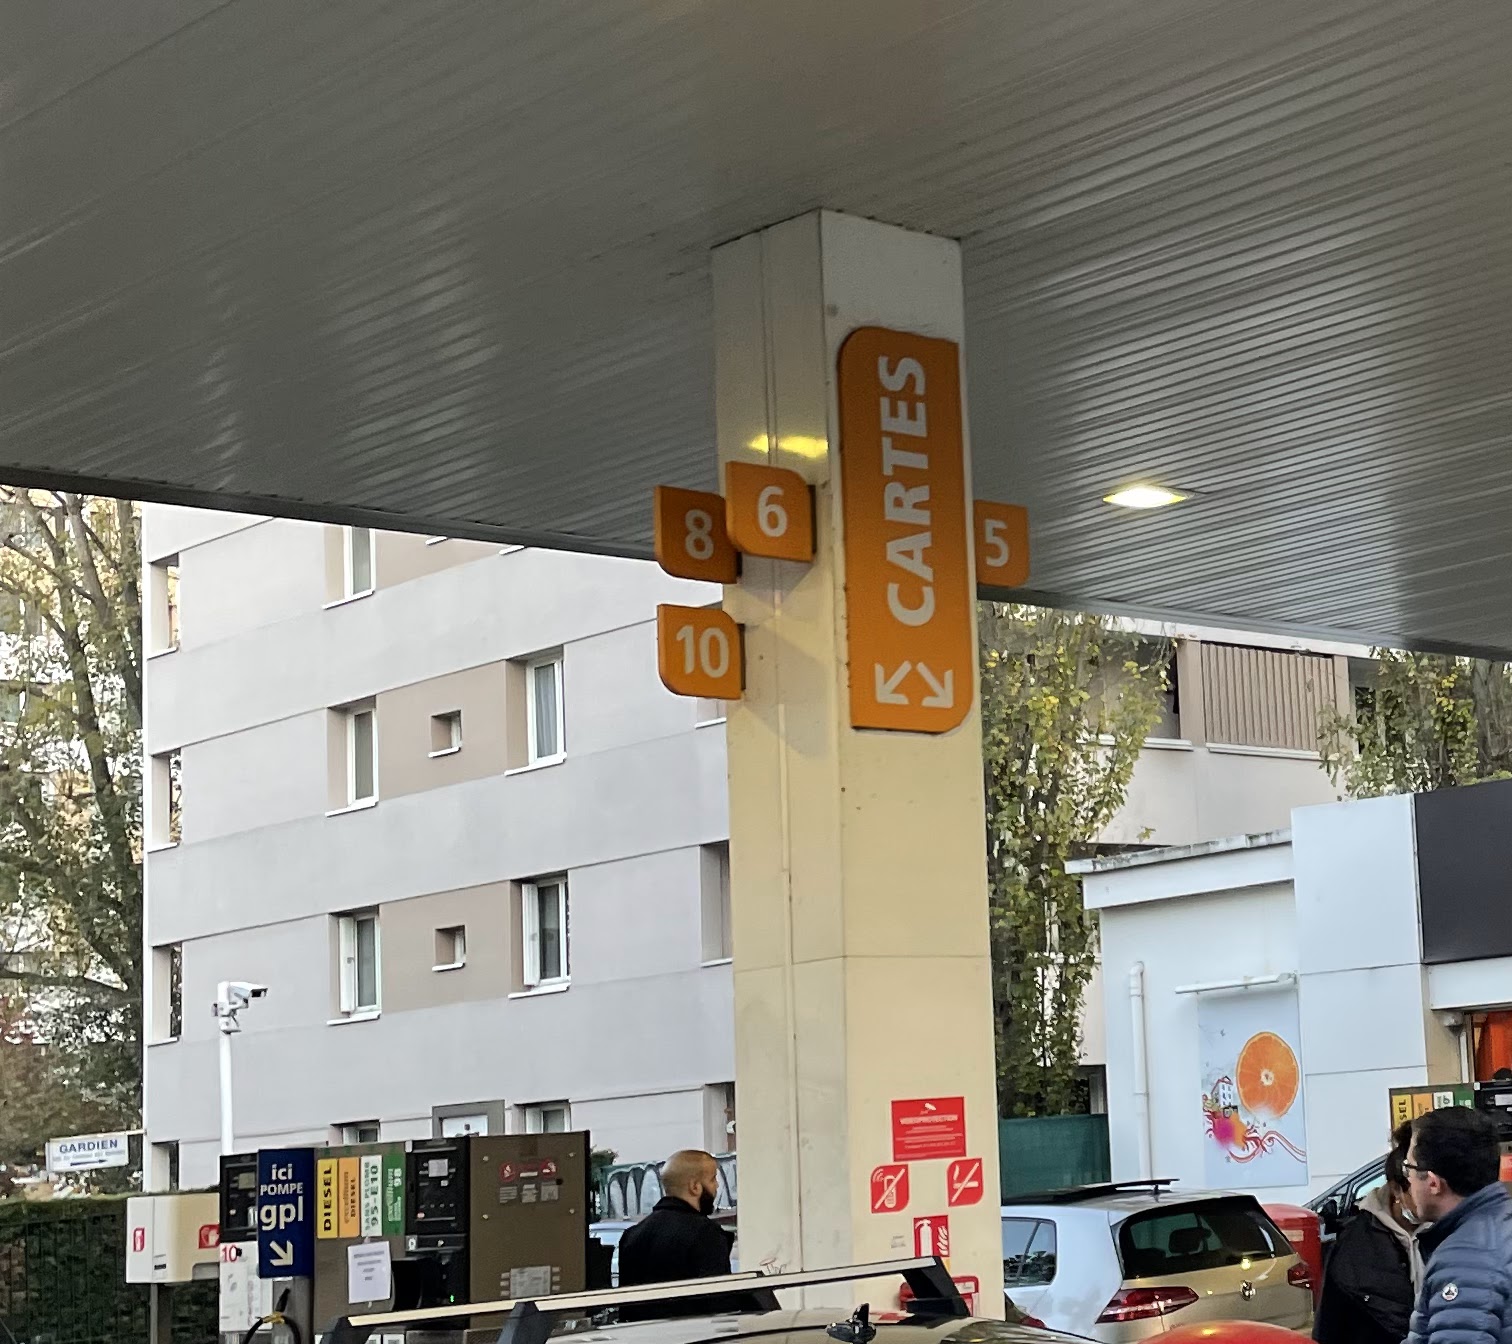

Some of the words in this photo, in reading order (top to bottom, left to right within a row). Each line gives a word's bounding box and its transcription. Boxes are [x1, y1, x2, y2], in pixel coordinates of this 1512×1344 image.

[756, 485, 788, 538] 6
[877, 355, 936, 627] CARTES
[684, 508, 715, 561] 8
[983, 520, 1009, 568] 5
[675, 623, 730, 678] 10
[59, 1139, 118, 1153] GARDIEN
[260, 1182, 304, 1196] POMPE
[271, 1163, 293, 1181] ici
[260, 1196, 304, 1231] gpl
[323, 1164, 332, 1232] DIESEL
[221, 1244, 238, 1263] 10
